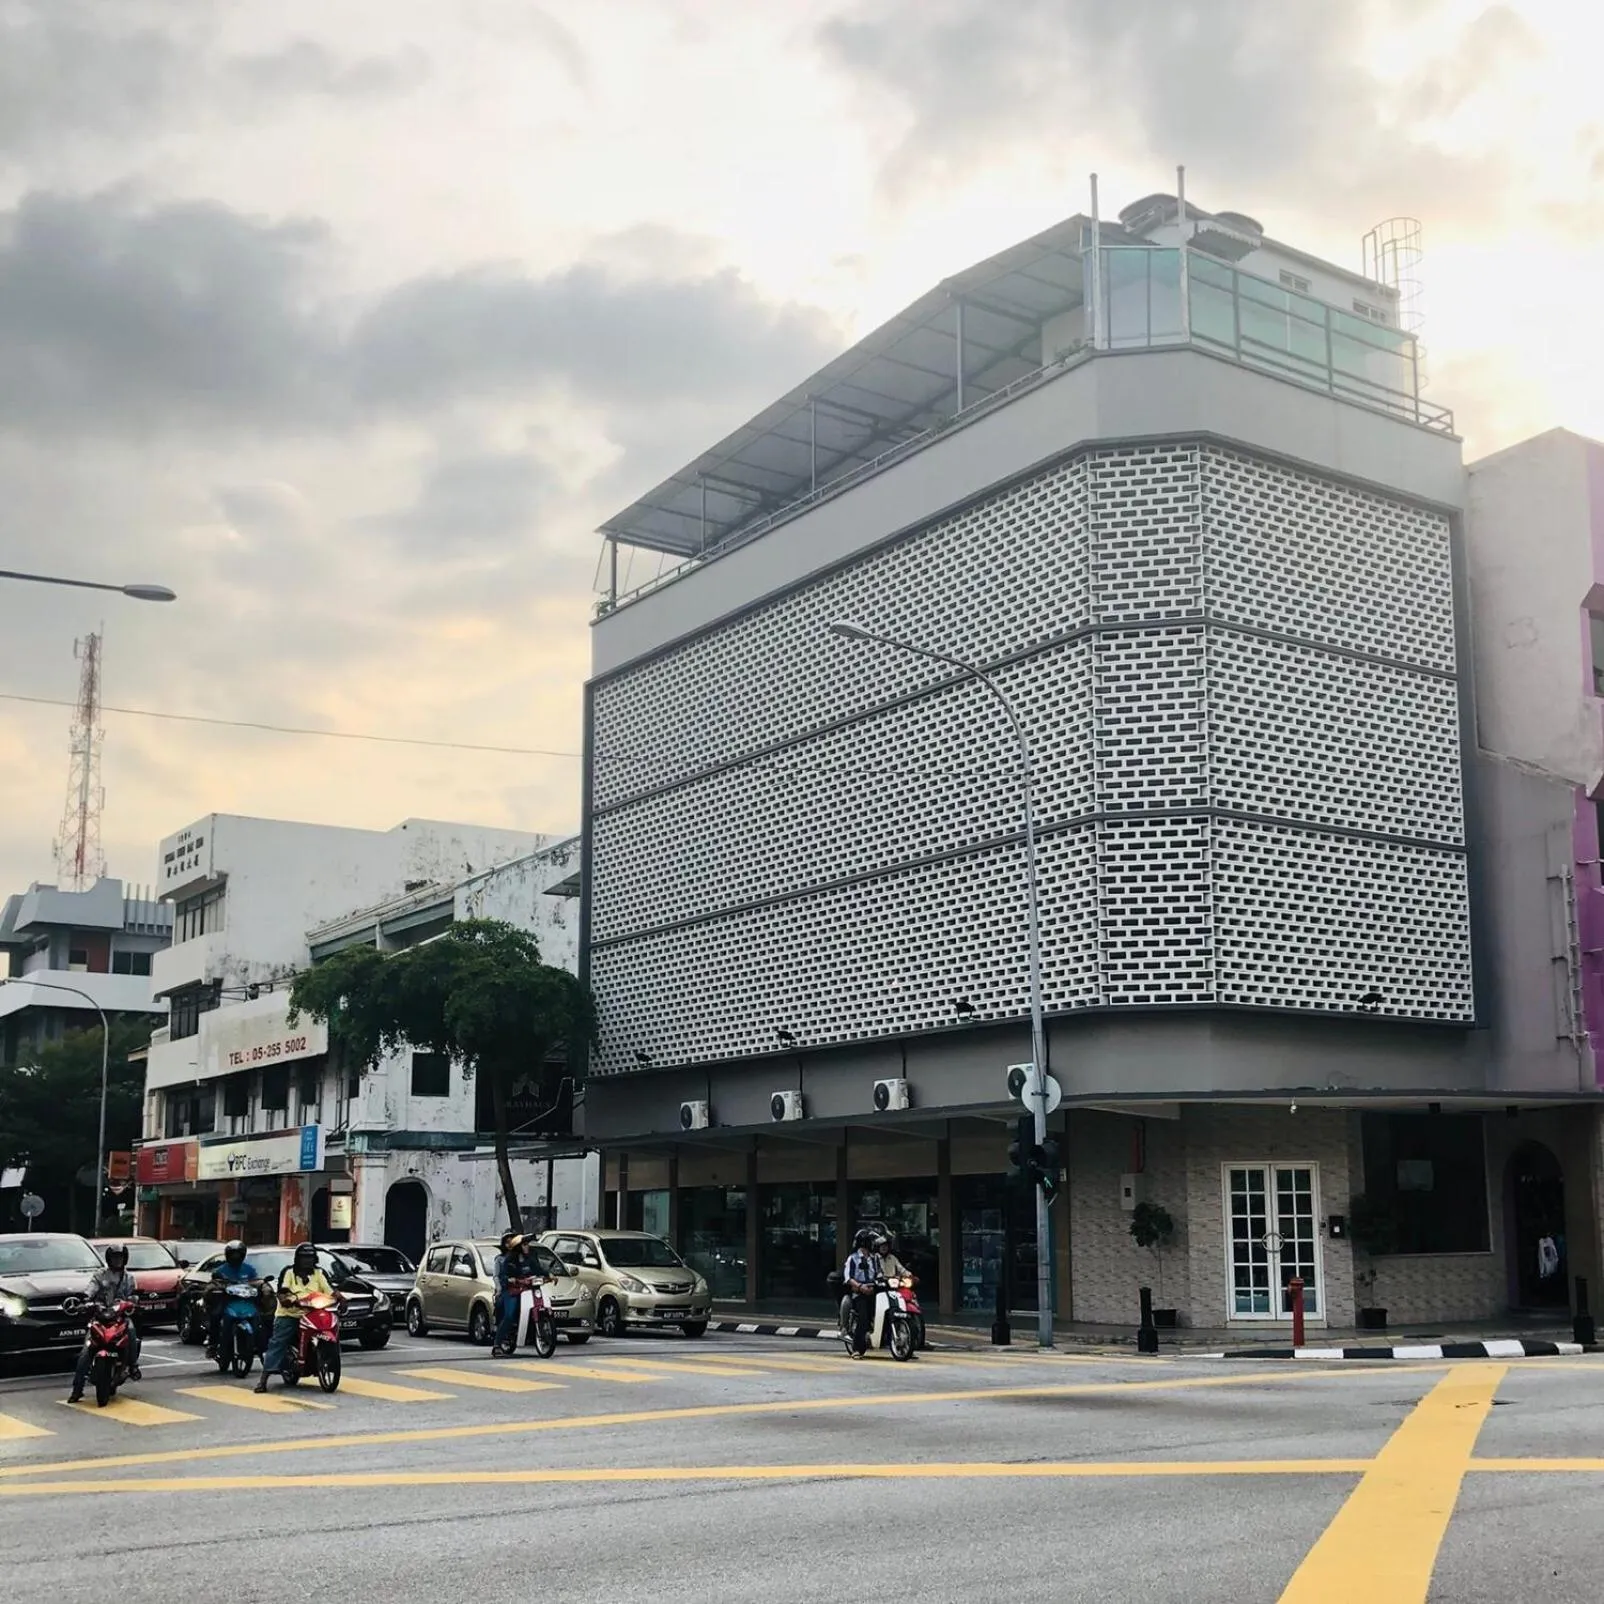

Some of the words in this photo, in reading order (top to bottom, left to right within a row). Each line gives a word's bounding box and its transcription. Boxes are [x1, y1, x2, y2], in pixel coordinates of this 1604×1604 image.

[229, 1051, 244, 1066] TEL
[252, 1042, 281, 1061] 05-255
[285, 1036, 307, 1054] 5002
